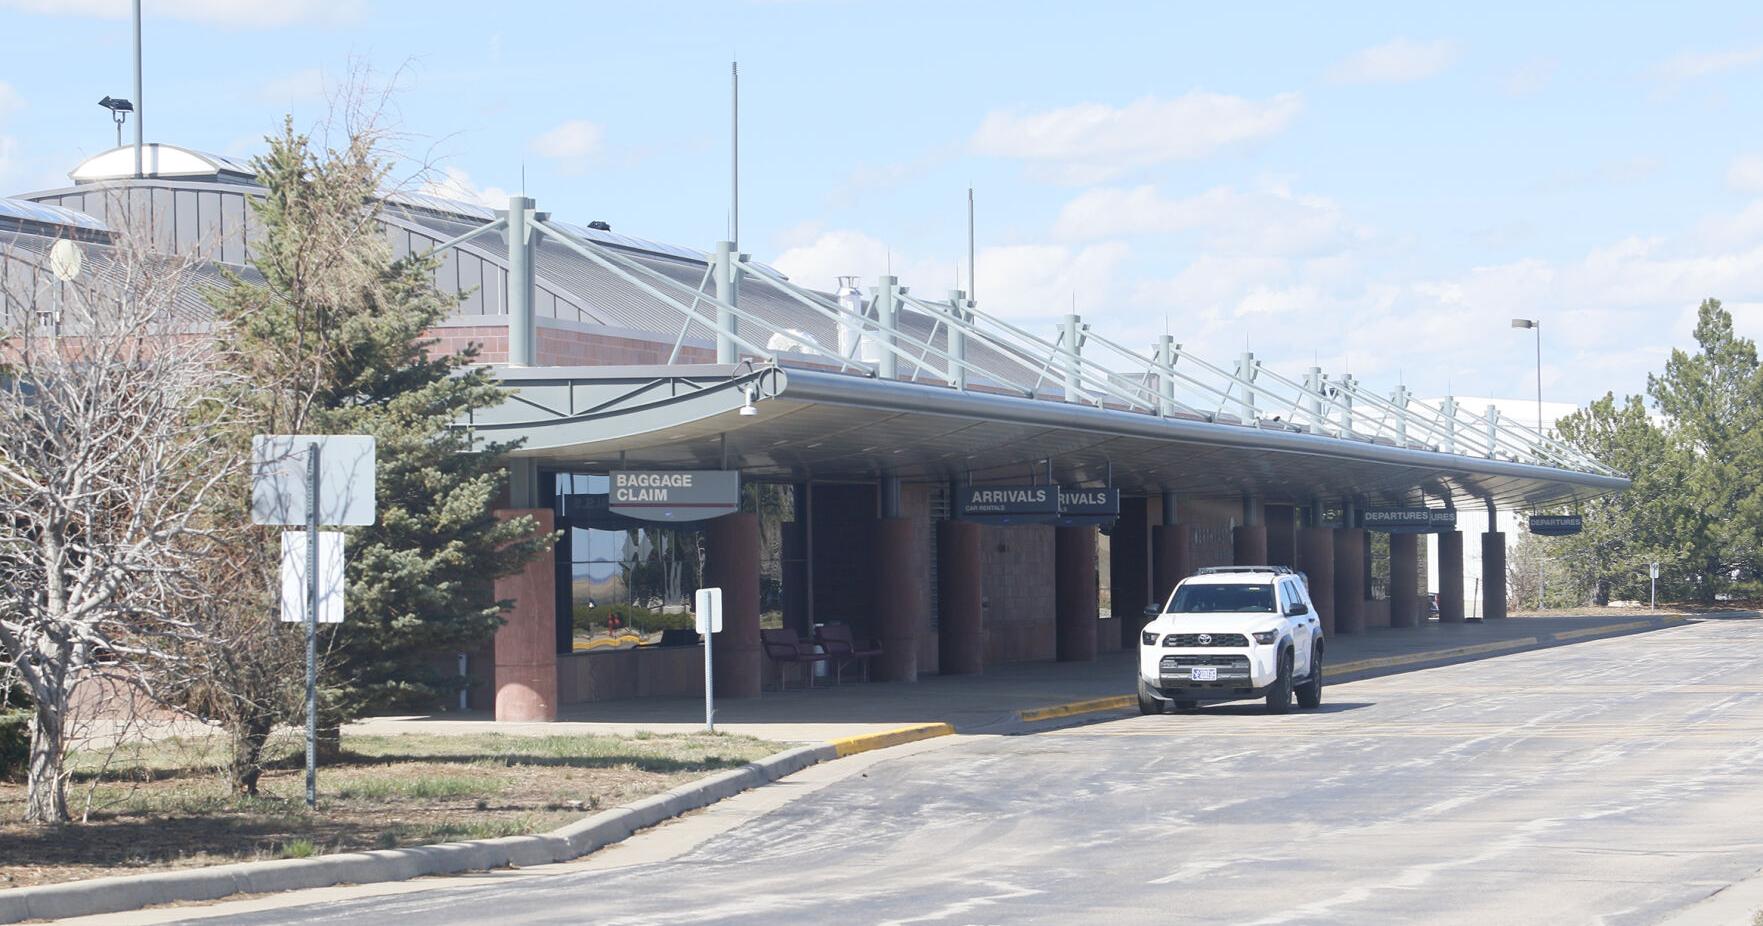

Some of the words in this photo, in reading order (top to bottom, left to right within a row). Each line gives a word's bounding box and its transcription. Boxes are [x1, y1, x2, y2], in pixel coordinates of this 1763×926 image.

[616, 474, 693, 487] BAGGAGE
[616, 488, 668, 501] CLAIM
[972, 490, 1047, 503] ARRIVALS
[1365, 511, 1429, 520] DEPARTURES
[1531, 518, 1581, 526] DEPARTURES
